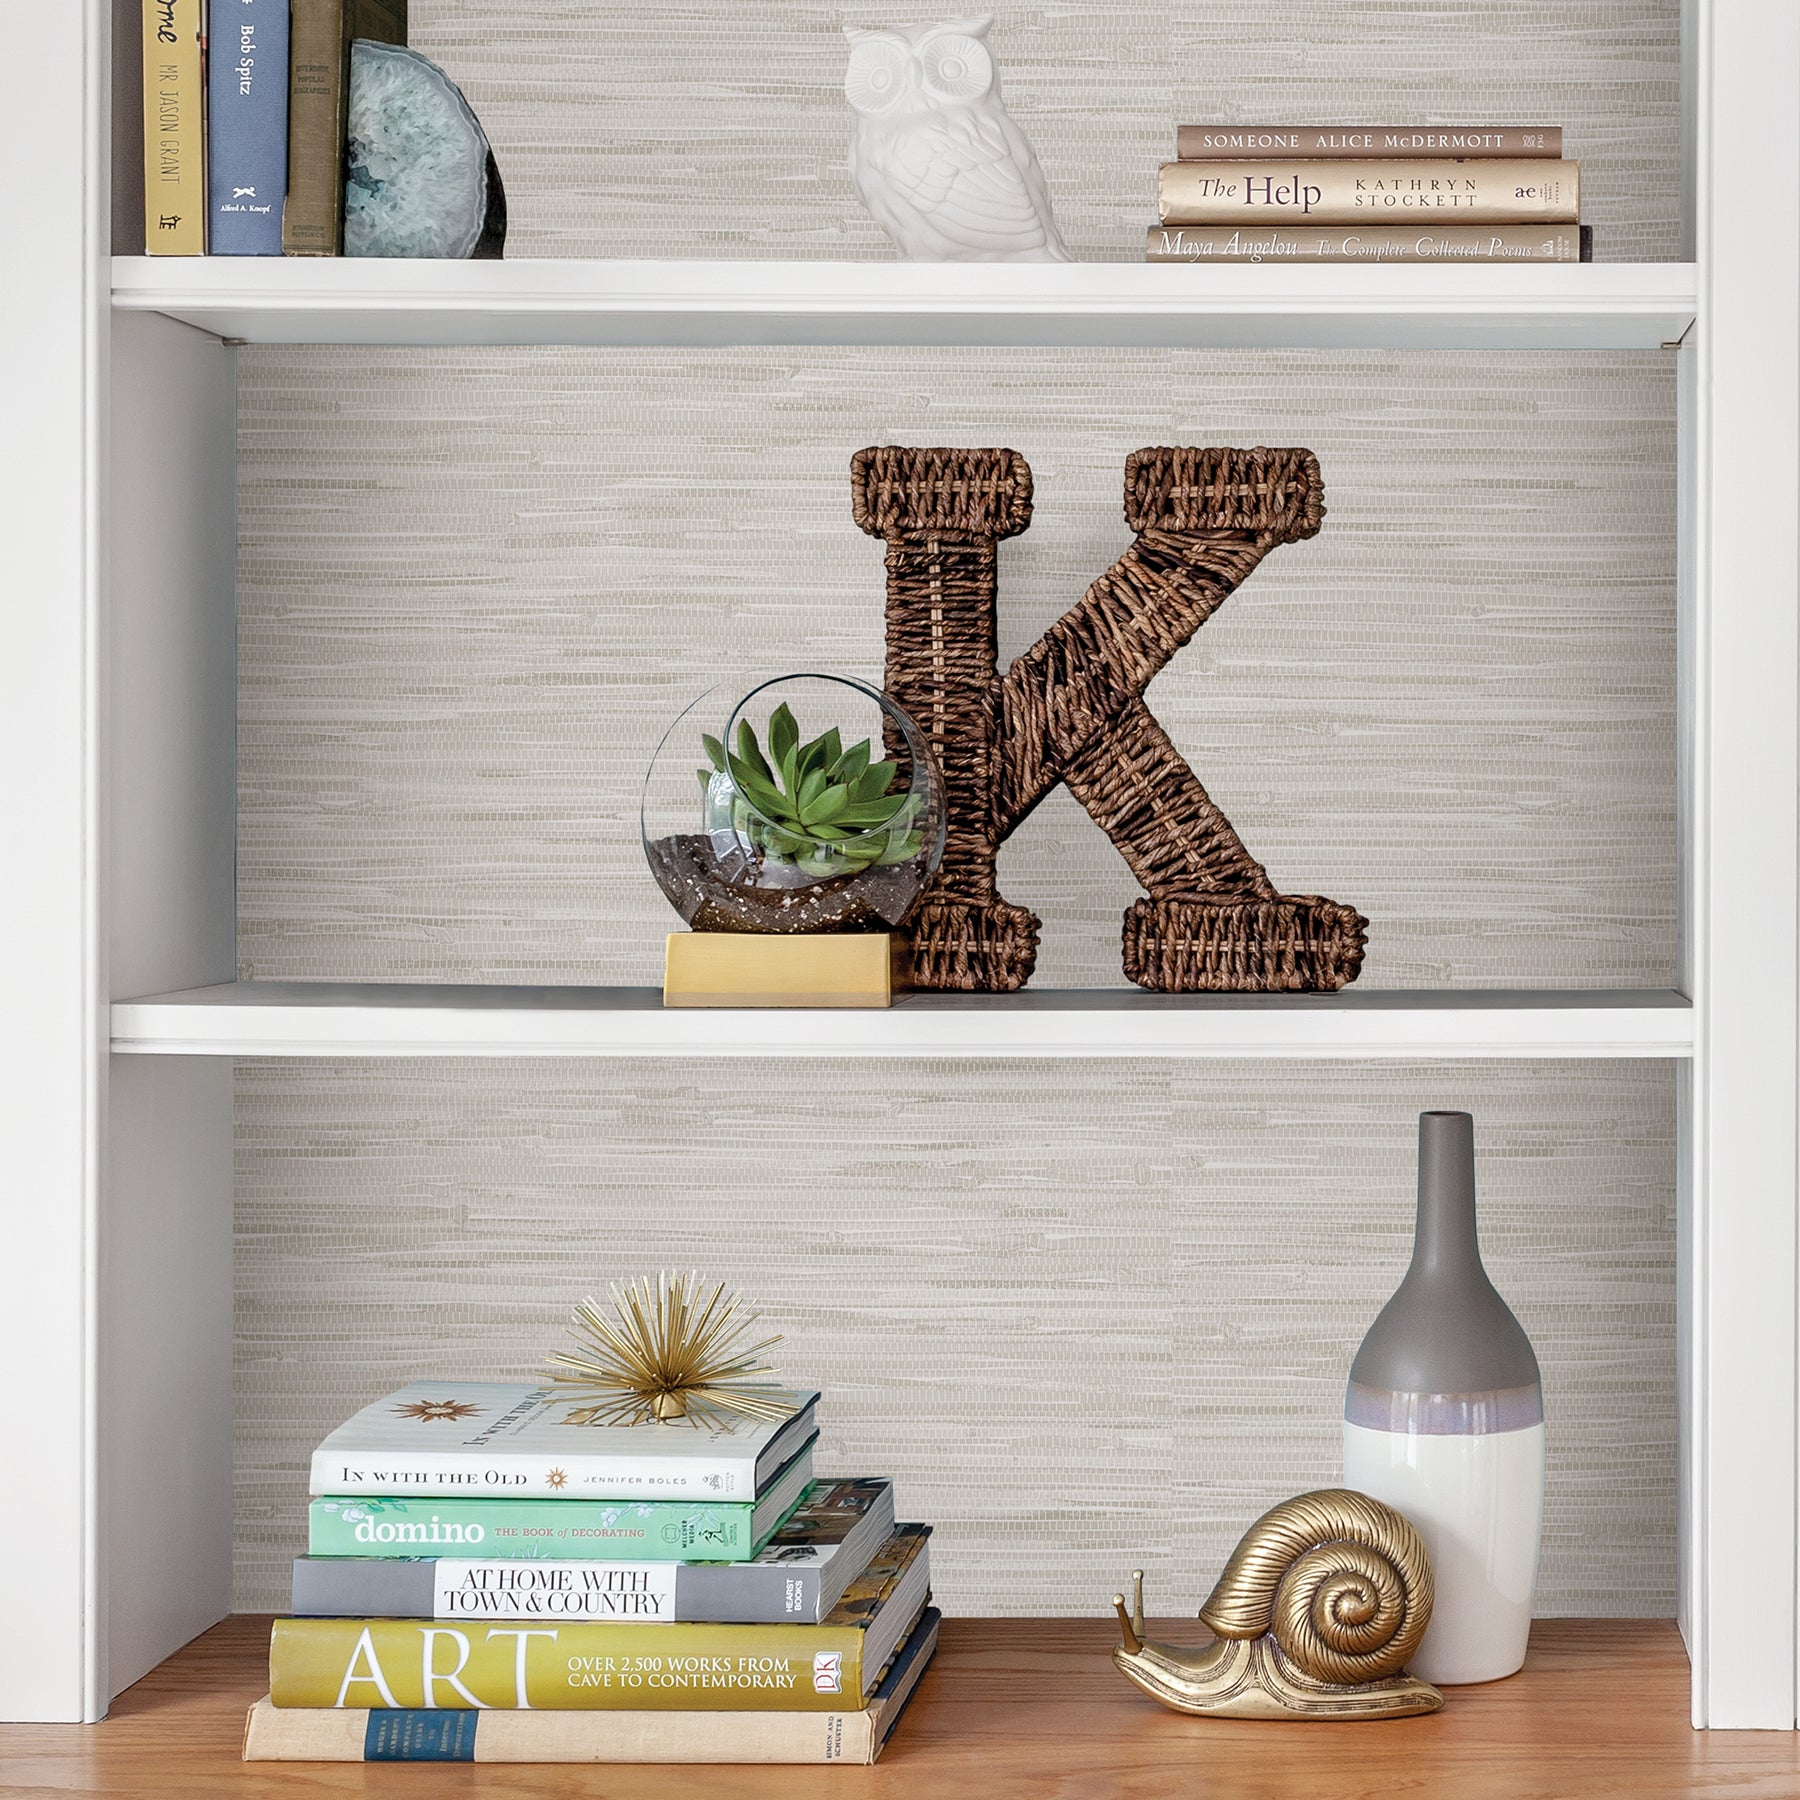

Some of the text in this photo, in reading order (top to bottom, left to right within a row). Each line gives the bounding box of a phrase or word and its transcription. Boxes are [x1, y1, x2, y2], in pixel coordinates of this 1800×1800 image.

[240, 25, 257, 54] Bob
[235, 57, 255, 95] Spitz
[159, 64, 180, 184] MR JASON GRANT
[1203, 134, 1504, 148] SOMEONE ALICE McDERMOTT
[1199, 175, 1322, 214] The Help
[1355, 179, 1476, 190] KATHRYN
[220, 204, 239, 212] Alfred
[249, 204, 272, 214] Knopf
[1355, 194, 1477, 206] STOCKETT
[1158, 230, 1533, 263] Maya Angelou The Complete Collected Poems
[583, 1476, 687, 1485] JENNIFER BOLES
[355, 1515, 485, 1544] domino
[494, 1527, 645, 1539] THE BOOK of DECORATING
[460, 1569, 651, 1592] AT HOME WITH
[785, 1578, 795, 1612] HEARST
[794, 1579, 803, 1611] BOOKS
[444, 1591, 667, 1614] TOWN & COUNTRY
[332, 1626, 558, 1709] ART
[568, 1656, 790, 1673] OVER 2,500 WORKS FROM
[815, 1658, 837, 1689] DK
[568, 1673, 797, 1689] CAVE TO CONTEMPORARY
[834, 1718, 843, 1757] SCHUSTER
